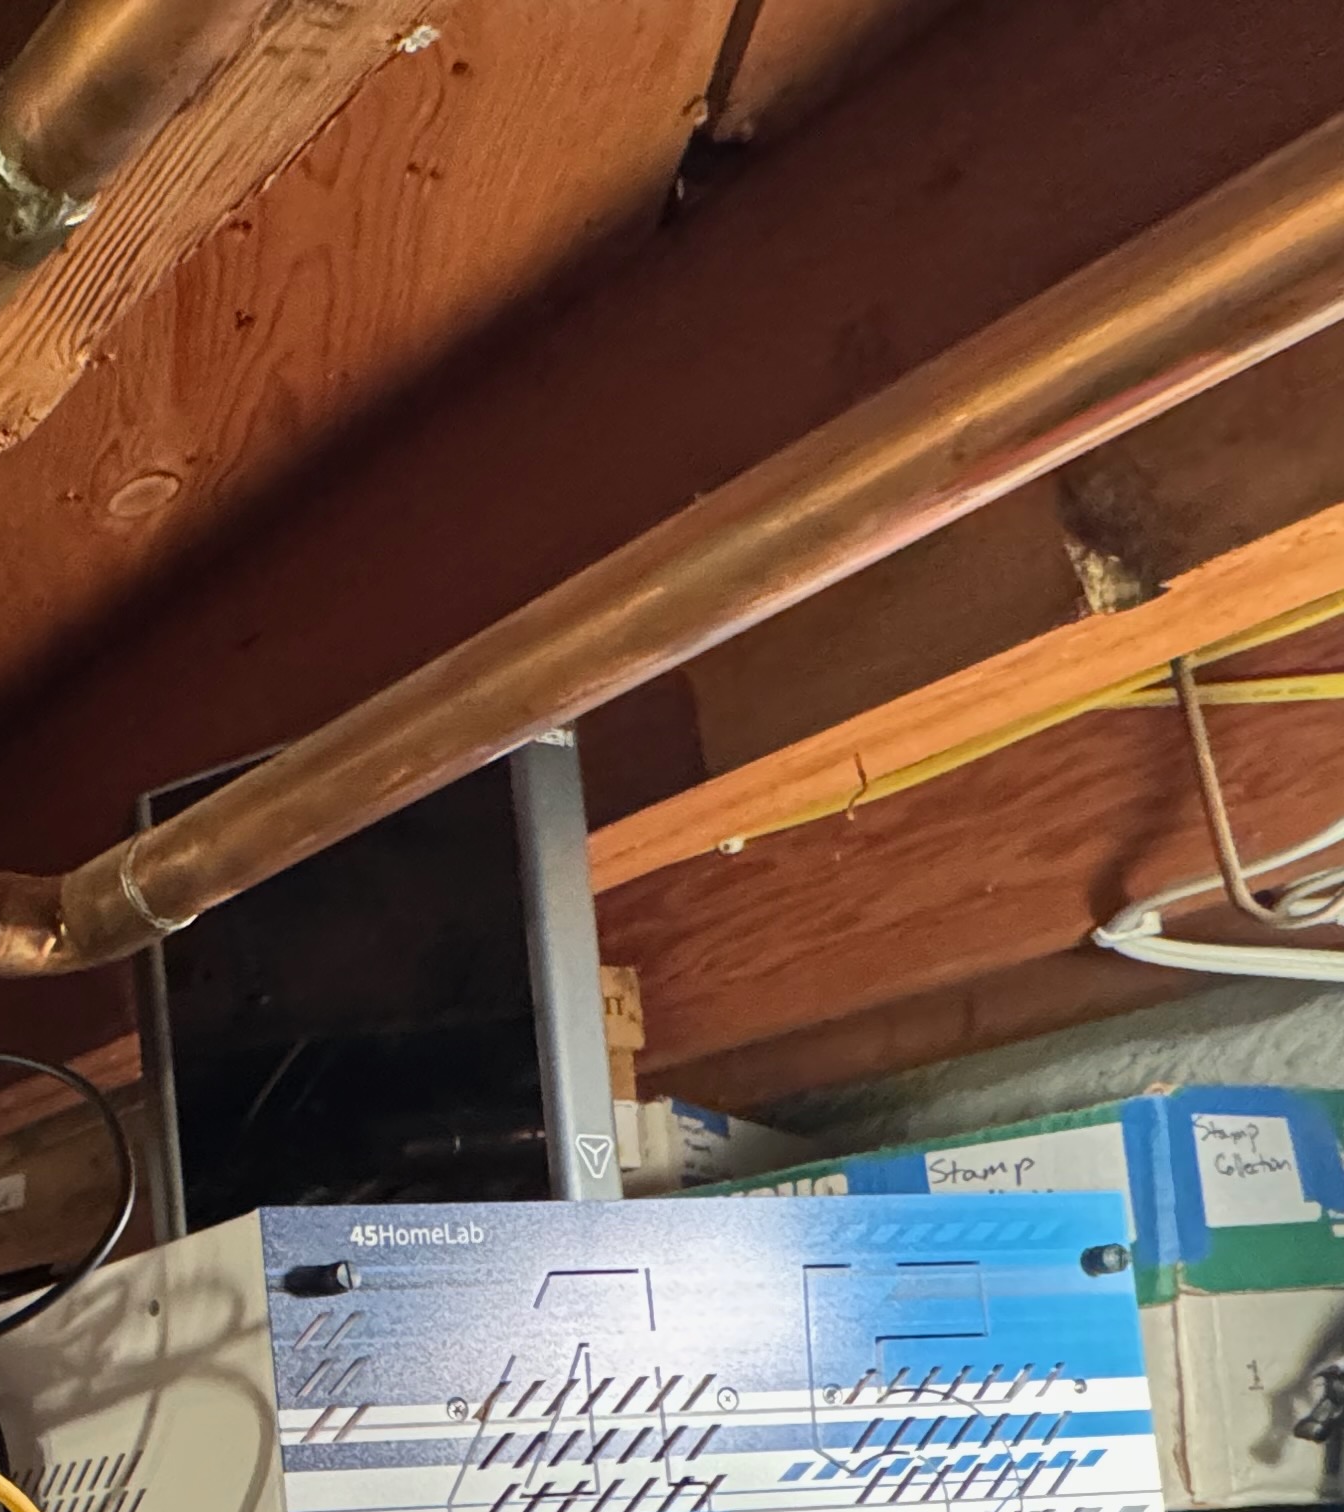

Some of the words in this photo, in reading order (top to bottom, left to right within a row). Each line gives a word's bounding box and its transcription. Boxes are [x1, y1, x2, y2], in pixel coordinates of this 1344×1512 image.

[1193, 1115, 1259, 1153] Stamp
[929, 1157, 1035, 1186] Stamp
[350, 1221, 484, 1247] 45HomeLab
